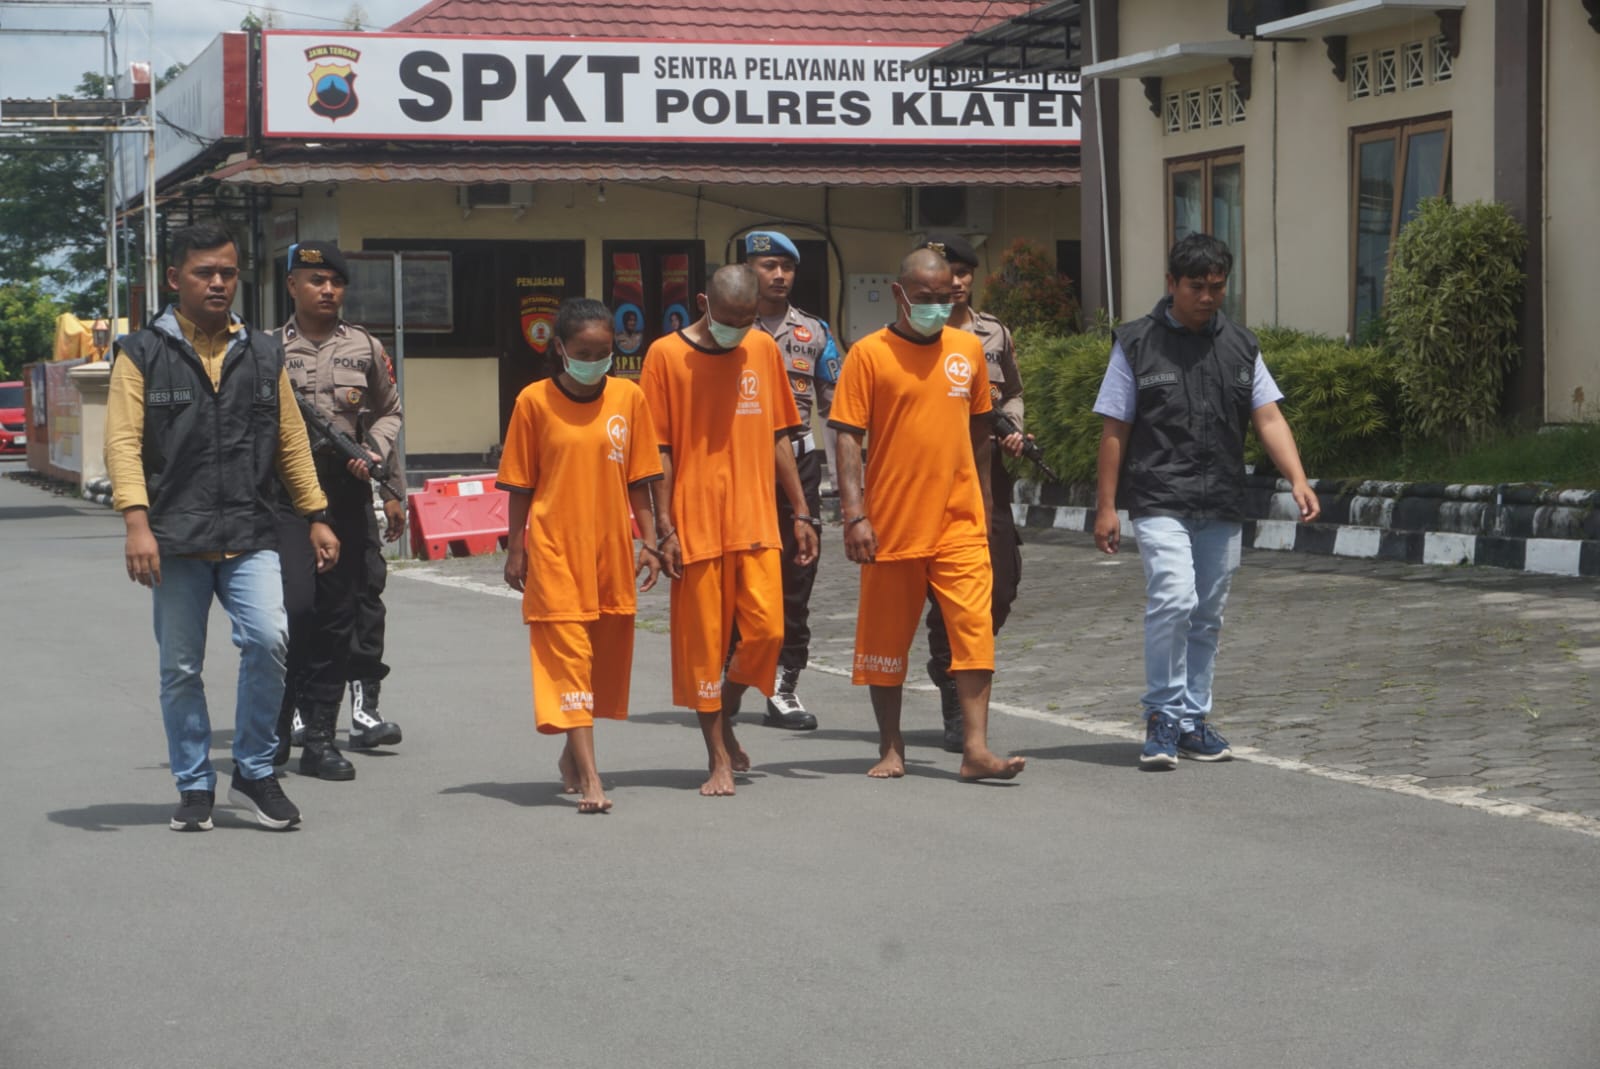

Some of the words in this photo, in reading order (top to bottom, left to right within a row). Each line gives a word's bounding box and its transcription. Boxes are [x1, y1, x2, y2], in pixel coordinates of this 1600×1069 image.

[654, 56, 738, 80] SENTRA
[744, 57, 866, 82] PELAYANAN
[398, 50, 640, 123] SPKT
[655, 88, 872, 126] POLRES
[516, 277, 565, 287] PENJAGAAN
[333, 358, 367, 369] POLRI
[615, 356, 642, 370] SPKT
[948, 361, 969, 377] 42
[740, 376, 756, 395] 12
